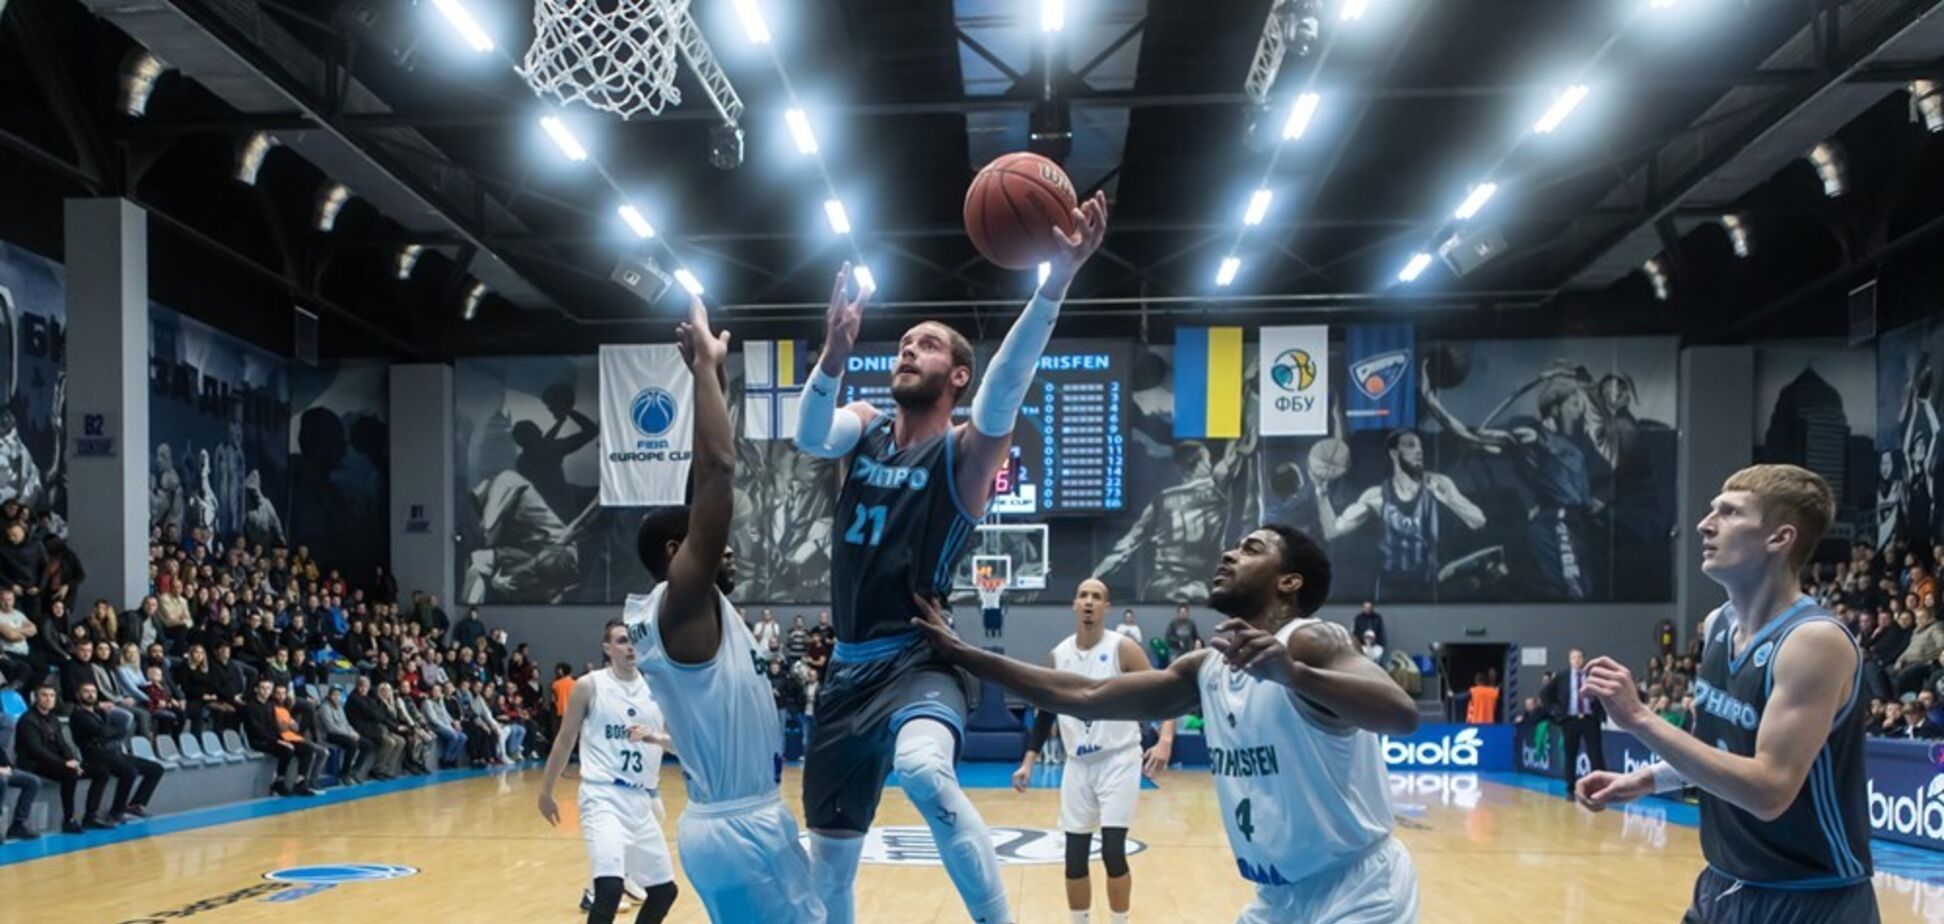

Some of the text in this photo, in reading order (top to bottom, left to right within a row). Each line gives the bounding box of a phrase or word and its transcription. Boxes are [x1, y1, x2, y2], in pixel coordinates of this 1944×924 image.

[1035, 355, 1109, 369] RISFEN
[1275, 396, 1315, 412] ФБУ
[637, 440, 669, 449] FIBA
[1107, 434, 1123, 444] 10
[1108, 445, 1122, 455] 11
[609, 452, 665, 462] EUROPE
[1108, 456, 1122, 465] 12
[1107, 467, 1122, 476] 14
[844, 502, 888, 547] 21
[1382, 729, 1483, 765] biola
[620, 749, 643, 773] 73
[1235, 798, 1254, 842] 4
